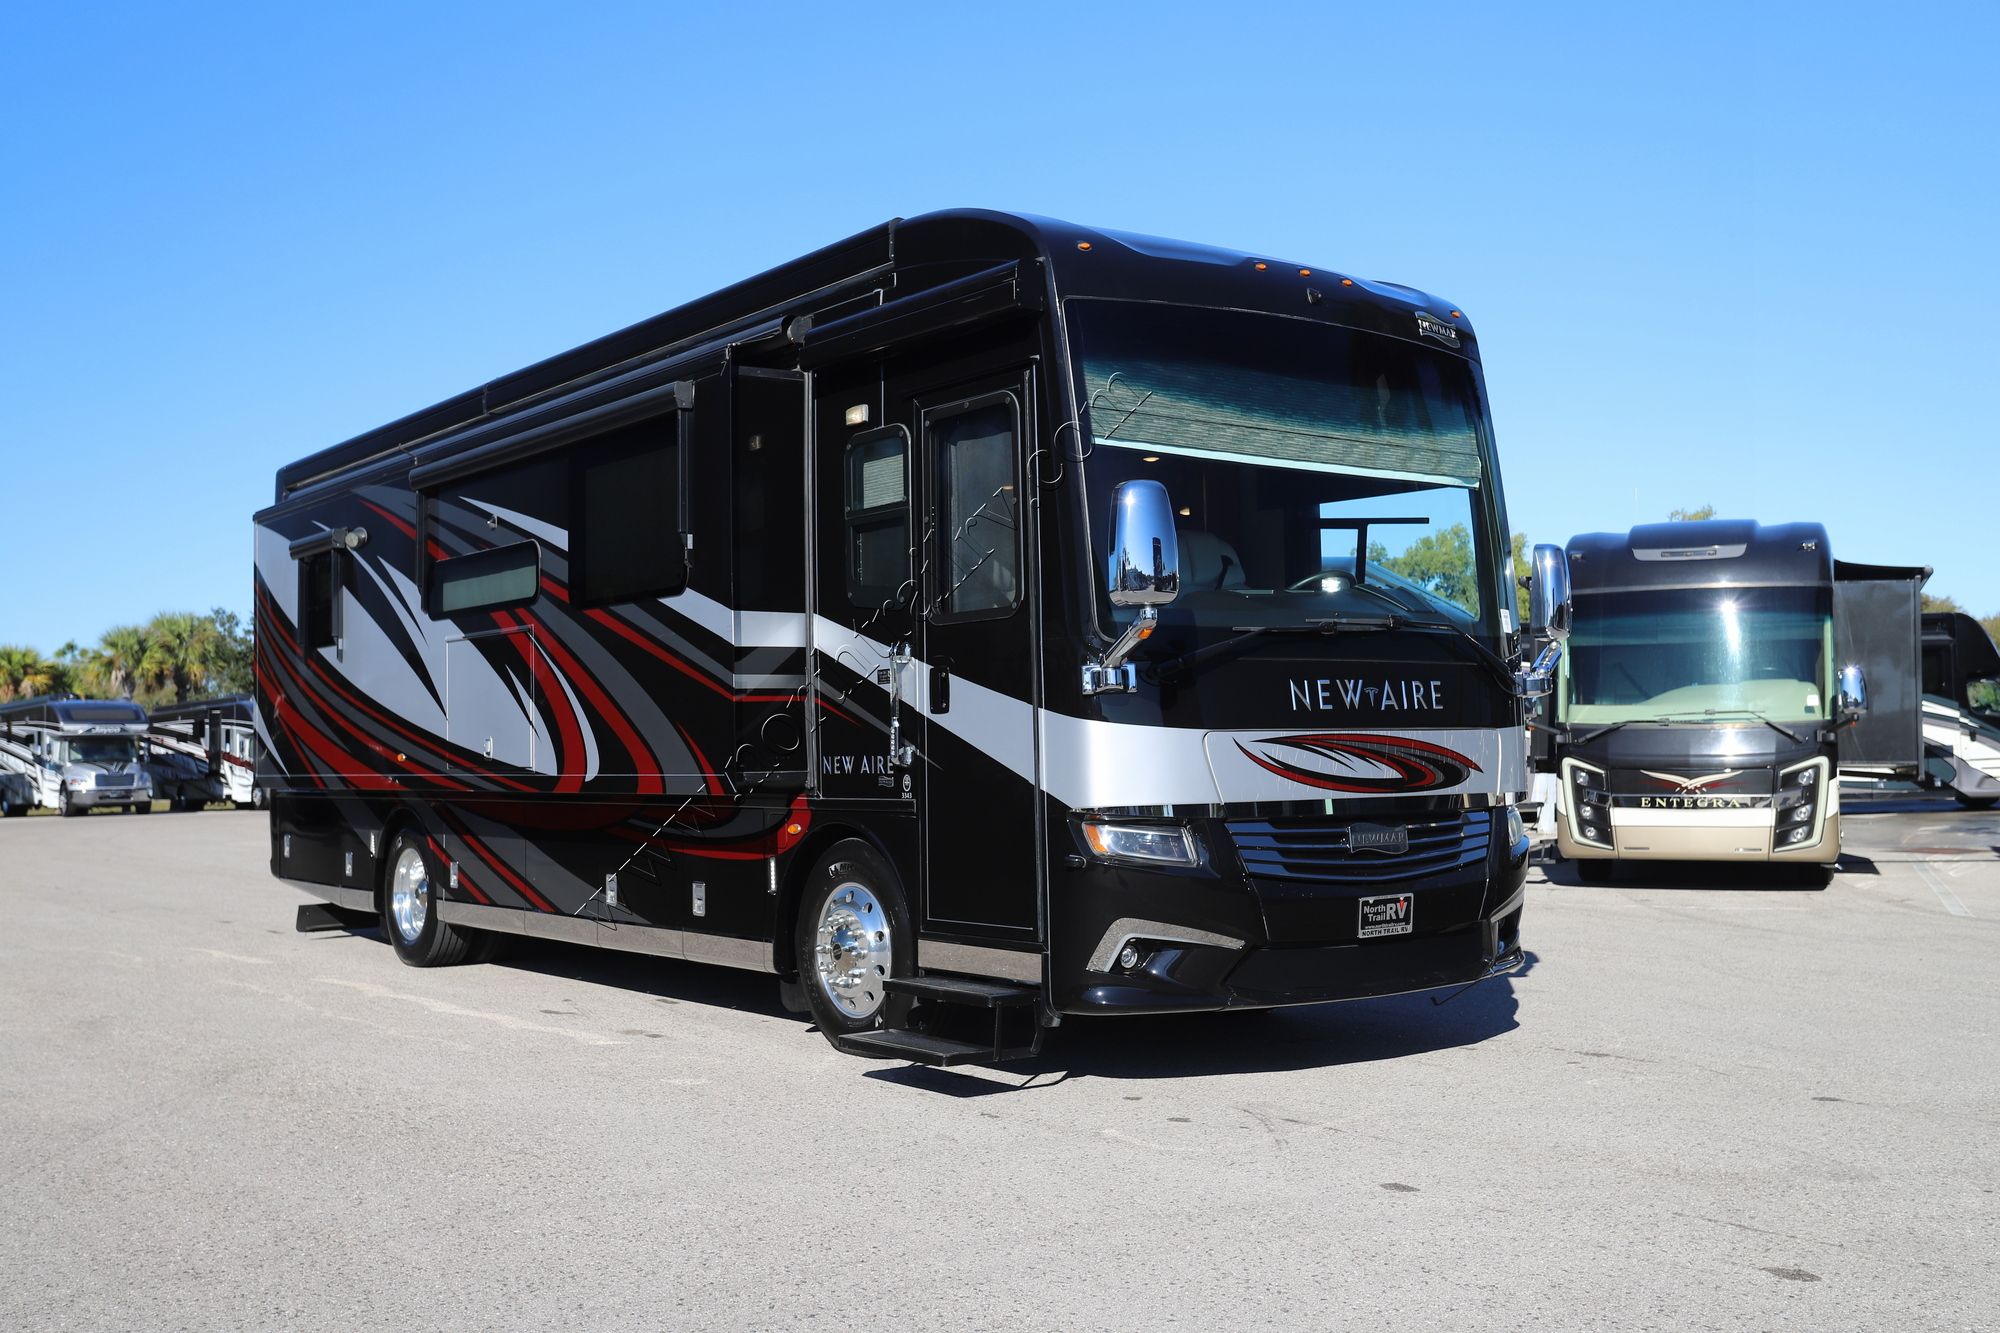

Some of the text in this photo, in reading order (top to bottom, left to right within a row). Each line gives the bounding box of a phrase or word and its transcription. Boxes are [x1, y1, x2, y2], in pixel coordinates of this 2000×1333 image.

[1289, 679, 1444, 711] NEW AIRE
[822, 755, 894, 775] NEW AIRE
[1641, 797, 1740, 808] ENTEGRA
[1363, 904, 1386, 914] North
[1386, 901, 1408, 921] RV
[1367, 913, 1386, 922] Trail
